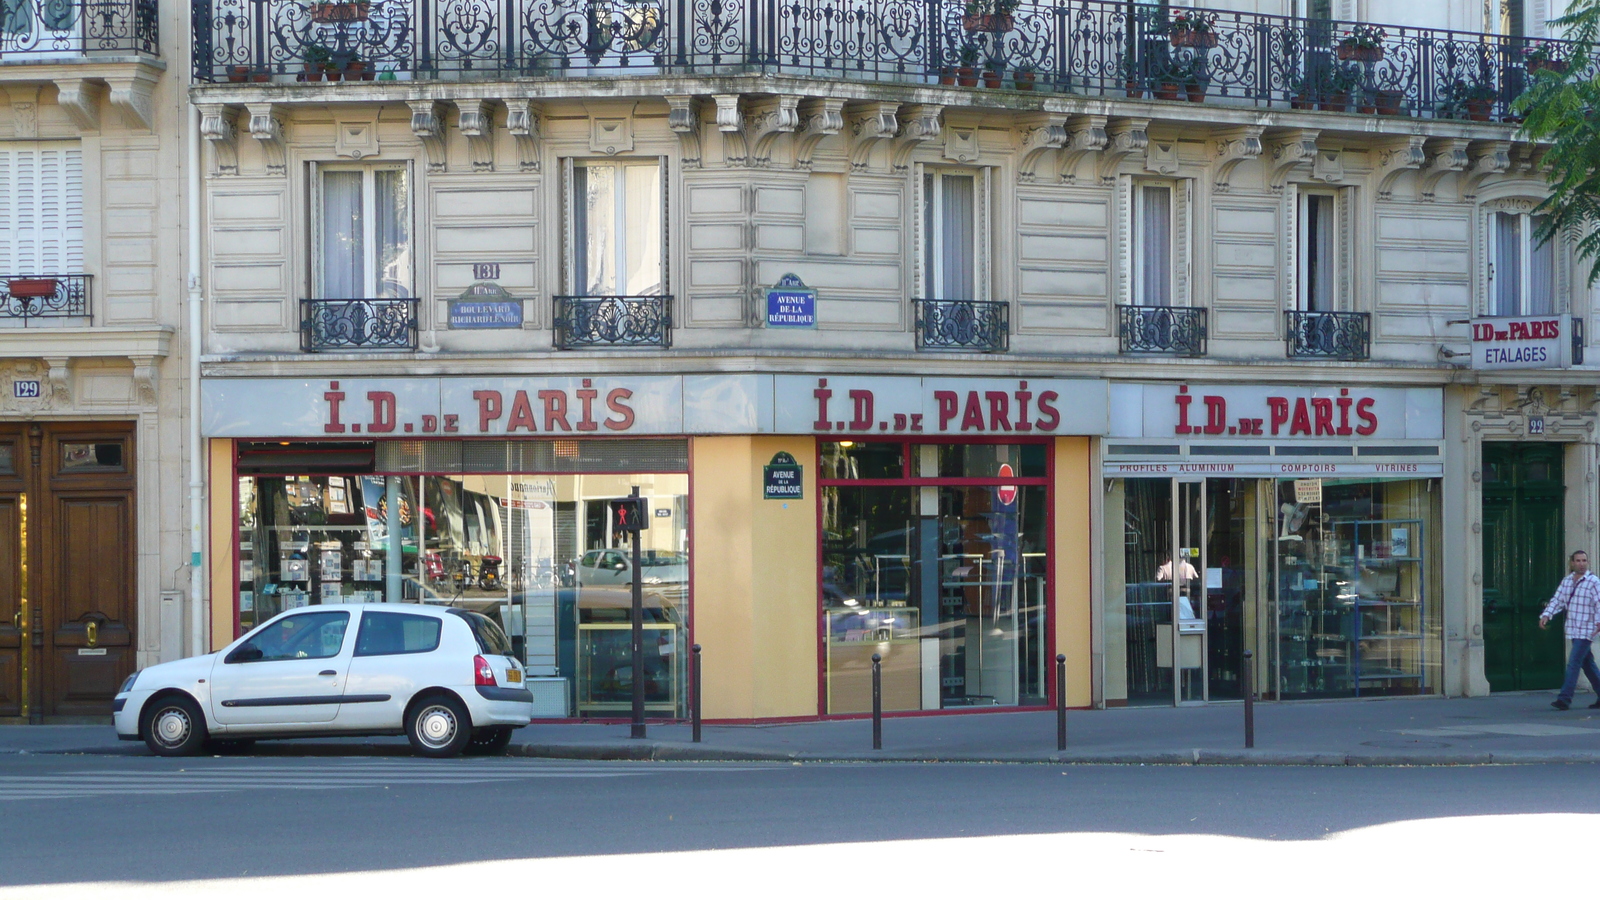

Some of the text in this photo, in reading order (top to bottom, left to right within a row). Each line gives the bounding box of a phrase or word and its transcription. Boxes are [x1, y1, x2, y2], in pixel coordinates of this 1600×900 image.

[476, 264, 498, 279] 131
[777, 296, 805, 304] AVENUE
[460, 305, 511, 314] BOULEVARD
[780, 305, 802, 313] DE LA
[769, 312, 814, 324] RÉPUBLIQUE
[1508, 320, 1559, 340] PARIS
[1485, 346, 1547, 363] ETALAGES
[15, 381, 38, 397] 129
[1530, 419, 1544, 433] 22
[1179, 464, 1235, 472] ALUMINIUM
[1281, 464, 1336, 472] COMPTOIRS
[1375, 464, 1418, 472] VITRINES
[766, 484, 801, 493] RÉPUBLIQUE
